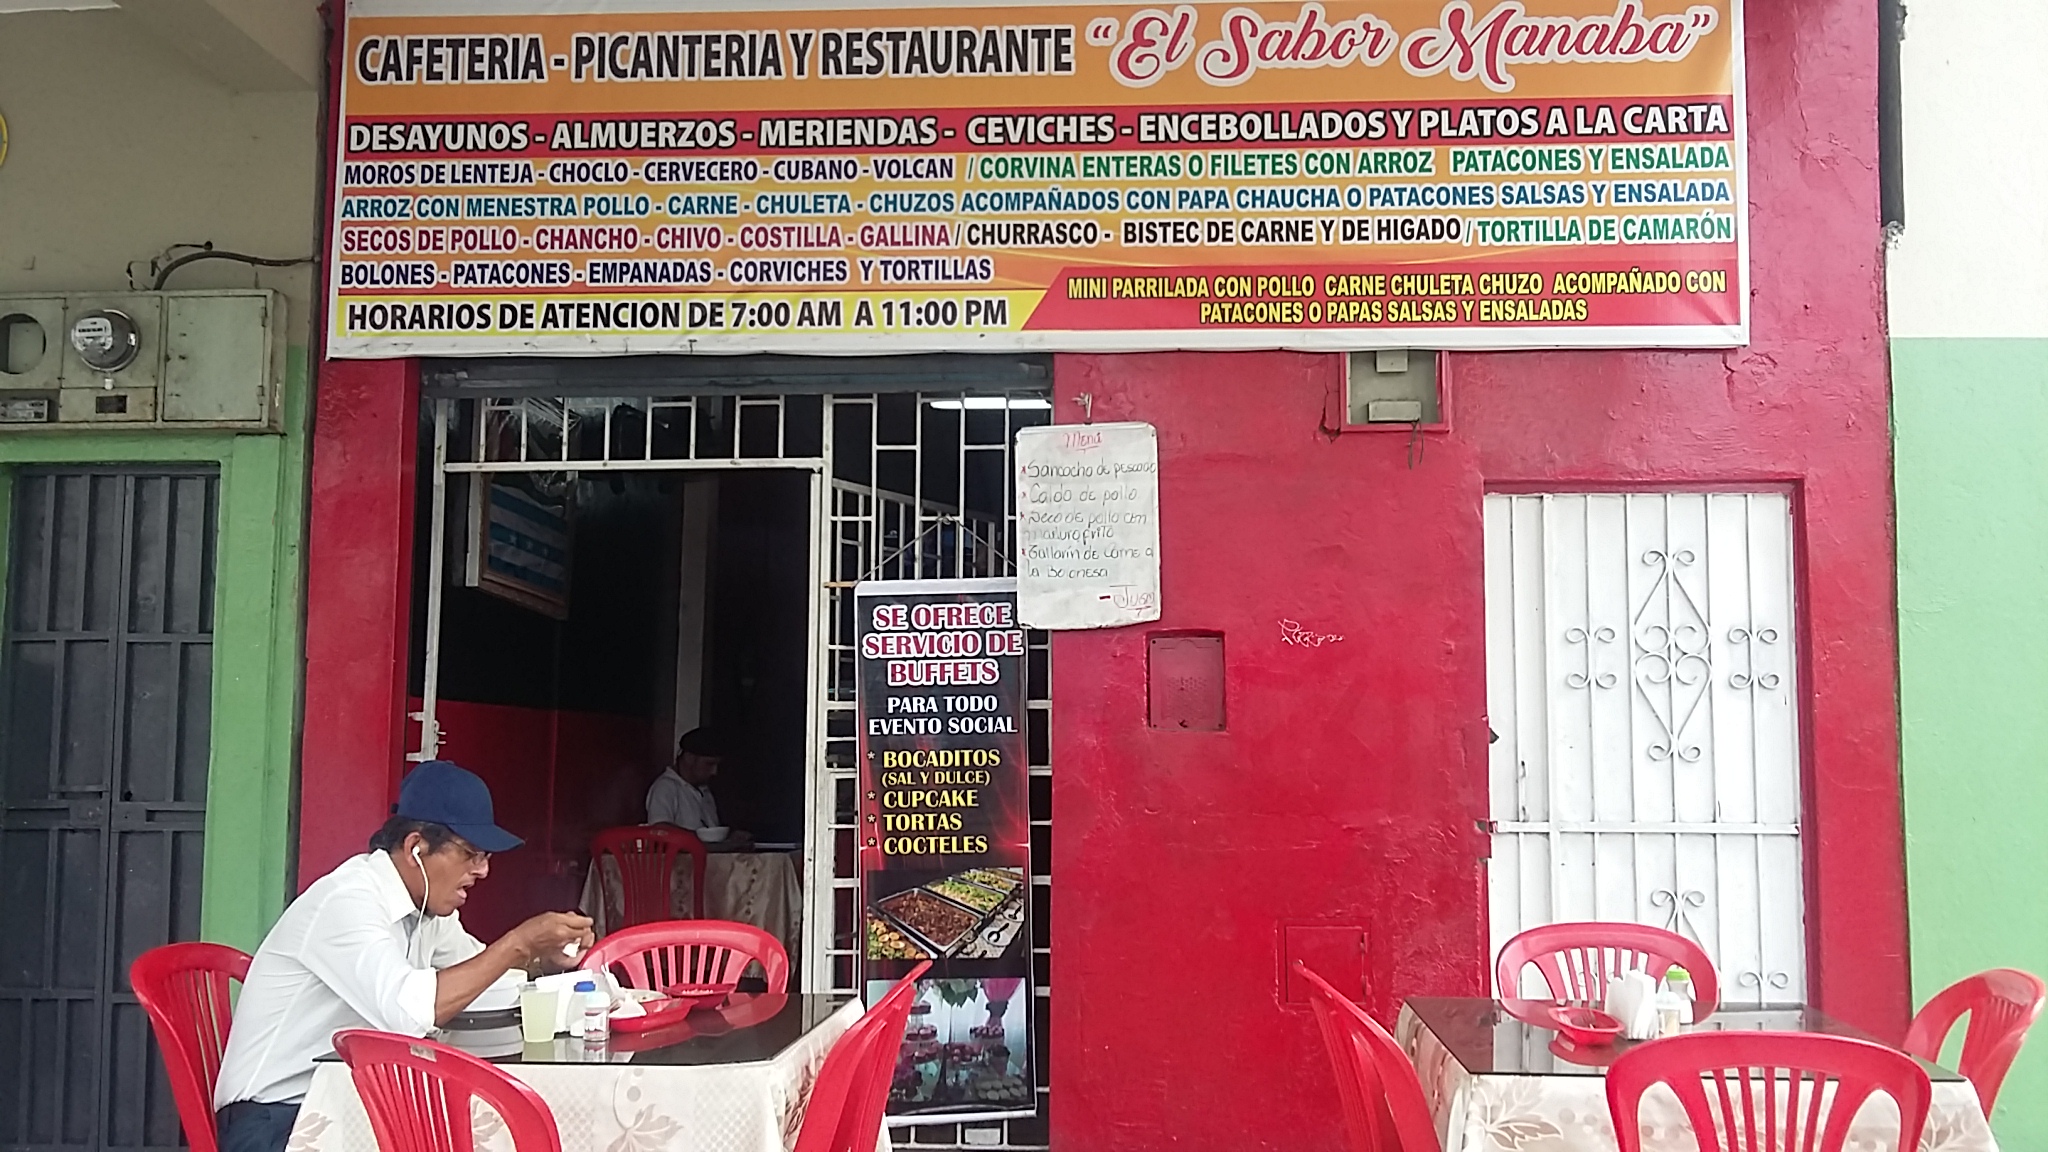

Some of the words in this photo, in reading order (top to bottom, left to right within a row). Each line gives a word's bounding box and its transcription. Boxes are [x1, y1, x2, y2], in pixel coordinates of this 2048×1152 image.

[357, 35, 547, 83] CAFETERIA
[574, 33, 783, 81] PICANTERIA
[790, 31, 813, 76] Y
[820, 27, 1073, 76] RESTAURANTE
[1202, 9, 1392, 80] Sabor
[349, 122, 528, 152] DESAYUNOS
[550, 120, 736, 149] ALMUERZOS
[759, 117, 938, 149] MERIENDAS
[967, 115, 1115, 145] CEVICHES
[1137, 110, 1387, 143] ENCEBOLLADOS
[1390, 110, 1414, 138] Y
[1420, 107, 1539, 137] PLATOS
[1545, 106, 1569, 135] A
[1576, 105, 1616, 135] LA
[1622, 104, 1729, 134] CARTA
[343, 163, 416, 186] MOROS
[419, 163, 447, 185] DE
[449, 161, 534, 185] LENTEJA
[548, 160, 630, 184] CHOCLO
[643, 159, 759, 183] CERVECERO
[773, 158, 859, 181] CUBANO
[873, 157, 954, 180] VOLCAN
[979, 156, 1076, 179] CORVINA
[1082, 155, 1182, 178] ENTERAS
[1187, 154, 1204, 177] O
[1210, 153, 1298, 177] FILETES
[1304, 151, 1351, 176] CON
[1357, 150, 1433, 174] ARROZ
[1451, 148, 1581, 173] PATACONES
[1588, 147, 1606, 171] Y
[1610, 146, 1730, 170] ENSALADA
[341, 197, 411, 219] ARROZ
[416, 197, 460, 218] CON
[465, 196, 578, 218] MENESTRA
[583, 195, 650, 217] POLLO
[667, 194, 738, 215] CARNE
[755, 193, 852, 215] CHULETA
[868, 192, 955, 214] CHUZOS
[961, 187, 1120, 212] ACOMPAÑADOS
[1125, 190, 1172, 212] CON
[1177, 189, 1230, 210] PAPA
[1235, 187, 1341, 210] CHAUCHA
[1345, 187, 1363, 209] O
[1368, 186, 1495, 208] PATACONES
[1500, 184, 1585, 206] SALSAS
[1591, 184, 1608, 205] Y
[1613, 181, 1730, 204] ENSALADA
[342, 229, 412, 252] SECOS
[417, 229, 445, 251] DE
[449, 228, 517, 251] POLLO
[535, 227, 639, 251] CHANCHO
[656, 226, 723, 250] CHIVO
[739, 225, 843, 249] COSTILLA
[859, 224, 951, 248] GALLINA
[967, 222, 1098, 246] CHURRASCO
[1122, 221, 1200, 244] BISTEC
[1205, 220, 1234, 244] DE
[1240, 219, 1314, 243] CARNE
[1319, 219, 1336, 242] Y
[1341, 218, 1370, 242] DE
[1376, 217, 1462, 241] HIGADO
[1478, 219, 1582, 242] TORTILLA
[1587, 218, 1617, 242] DE
[1623, 212, 1732, 241] CAMARÓN
[340, 263, 436, 286] BOLONES
[452, 261, 571, 285] PATACONES
[588, 261, 712, 285] EMPANADAS
[729, 259, 848, 283] CORVICHES
[859, 260, 877, 282] Y
[879, 258, 992, 282] TORTILLAS
[1067, 277, 1108, 299] MINI
[1111, 276, 1210, 299] PARRILADA
[1213, 276, 1253, 298] CON
[1256, 274, 1315, 298] POLLO
[1323, 274, 1387, 297] CARNE
[1390, 273, 1475, 296] CHULETA
[1479, 272, 1544, 295] CHUZO
[1552, 267, 1681, 294] ACOMPAÑADO
[1685, 270, 1727, 293] CON
[347, 303, 493, 331] HORARIOS
[497, 303, 536, 330] DE
[540, 302, 682, 330] ATENCION
[687, 302, 725, 329] DE
[730, 301, 791, 328] 7:00
[796, 300, 842, 328] AM
[854, 299, 875, 327] A
[881, 299, 959, 327] 11:00
[964, 299, 1008, 326] PM
[1200, 301, 1303, 325] PATACONES
[1308, 301, 1323, 323] O
[1326, 301, 1383, 322] PAPAS
[1387, 301, 1457, 322] SALSAS
[1460, 300, 1476, 321] Y
[1479, 299, 1588, 321] ENSALADAS
[1103, 486, 1138, 506] pollo
[1088, 511, 1120, 529] pollo
[874, 606, 908, 628] SE
[912, 604, 1012, 628] OFRECE
[862, 633, 983, 657] SERVICIO
[987, 632, 1024, 655] DE
[888, 660, 998, 684] BUFFETS
[887, 696, 939, 714] PARA
[943, 695, 998, 713] TODO
[868, 717, 943, 736] EVENTO
[947, 716, 1018, 734] SOCIAL
[882, 749, 1001, 768] BOCADITOS
[881, 772, 917, 787] (SAL
[919, 772, 931, 785] Y
[934, 770, 991, 786] DULCE)
[883, 790, 980, 809] CUPCAKE
[883, 813, 963, 832] TORTAS
[883, 835, 989, 855] COCTELES
